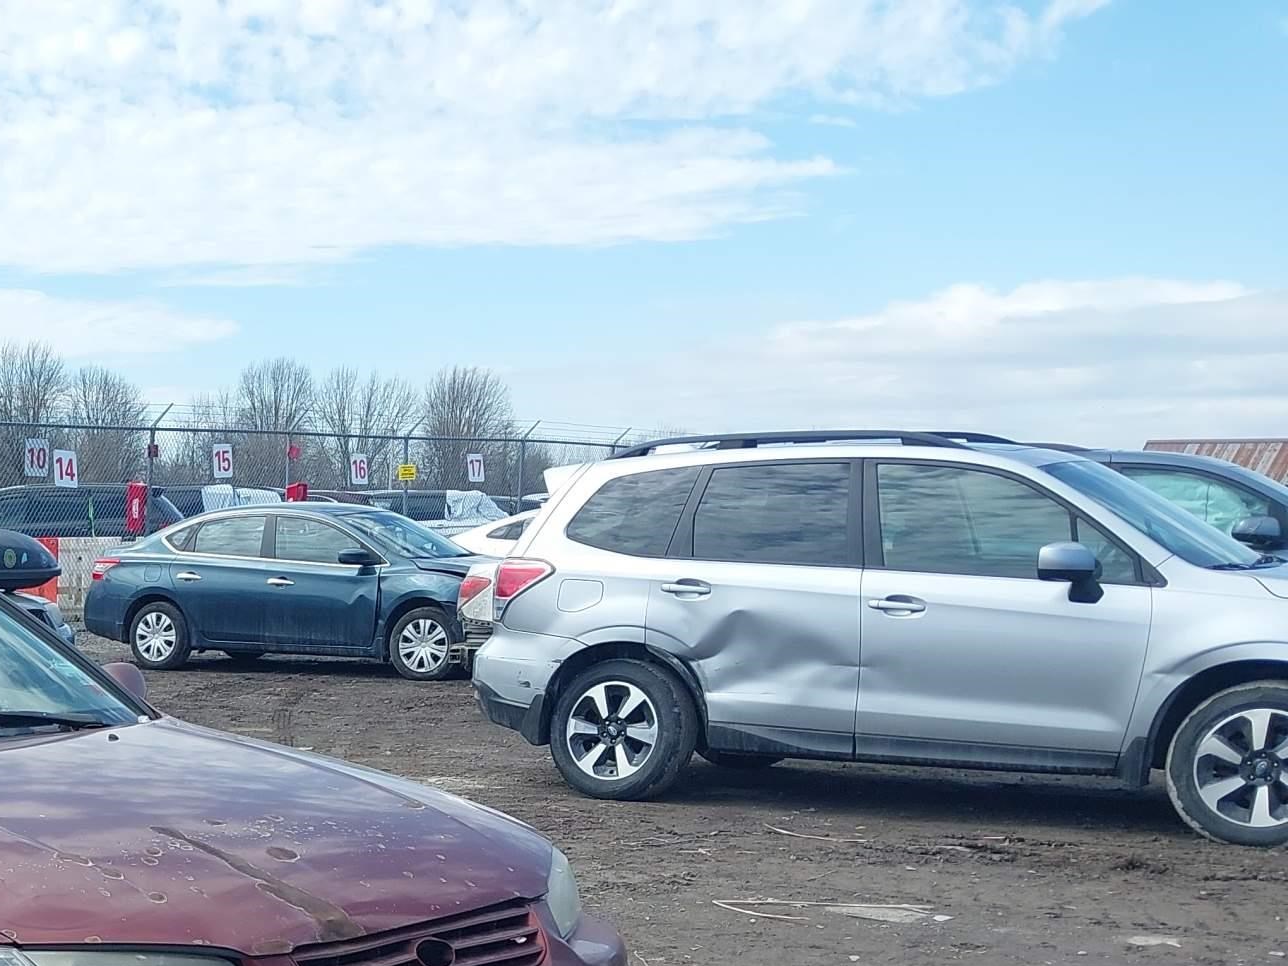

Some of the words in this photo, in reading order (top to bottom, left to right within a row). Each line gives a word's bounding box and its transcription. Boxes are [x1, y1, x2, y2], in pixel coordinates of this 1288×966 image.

[28, 447, 46, 469] 10
[56, 456, 75, 481] 14
[215, 450, 231, 472] 15
[352, 459, 367, 479] 16
[469, 459, 481, 478] 17
